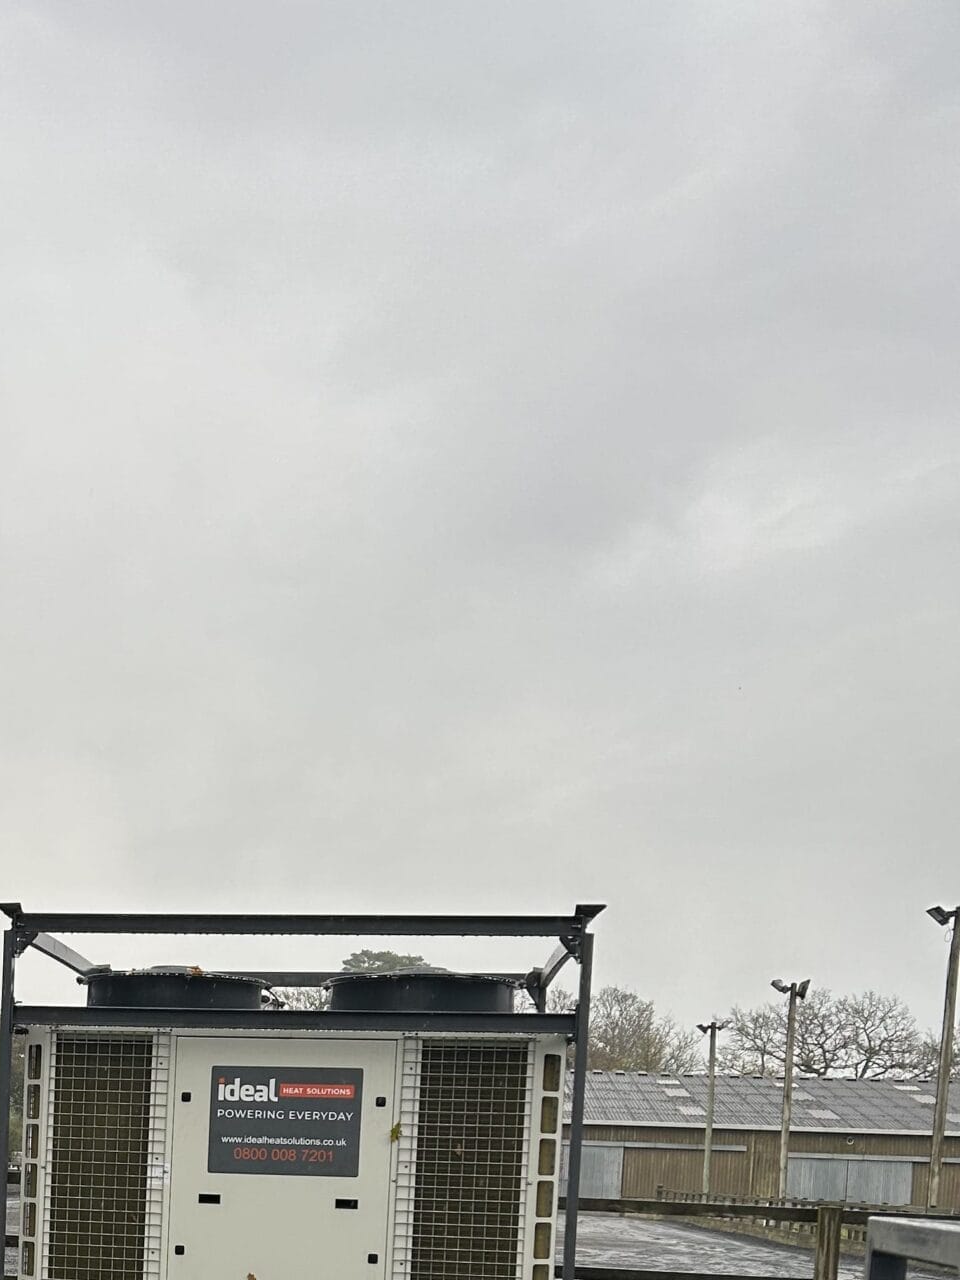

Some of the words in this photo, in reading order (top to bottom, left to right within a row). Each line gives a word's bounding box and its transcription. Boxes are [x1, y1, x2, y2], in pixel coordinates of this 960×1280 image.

[218, 1077, 278, 1102] ideal
[282, 1087, 303, 1095] HEAT
[306, 1087, 351, 1096] SOLUTIONS
[217, 1109, 285, 1120] POWERING
[288, 1111, 354, 1121] EVERYDAY
[221, 1135, 347, 1147] www.idealheatsolutions.co.uk
[234, 1148, 267, 1160] 0800
[271, 1149, 296, 1161] 008
[301, 1150, 333, 1162] 7201
